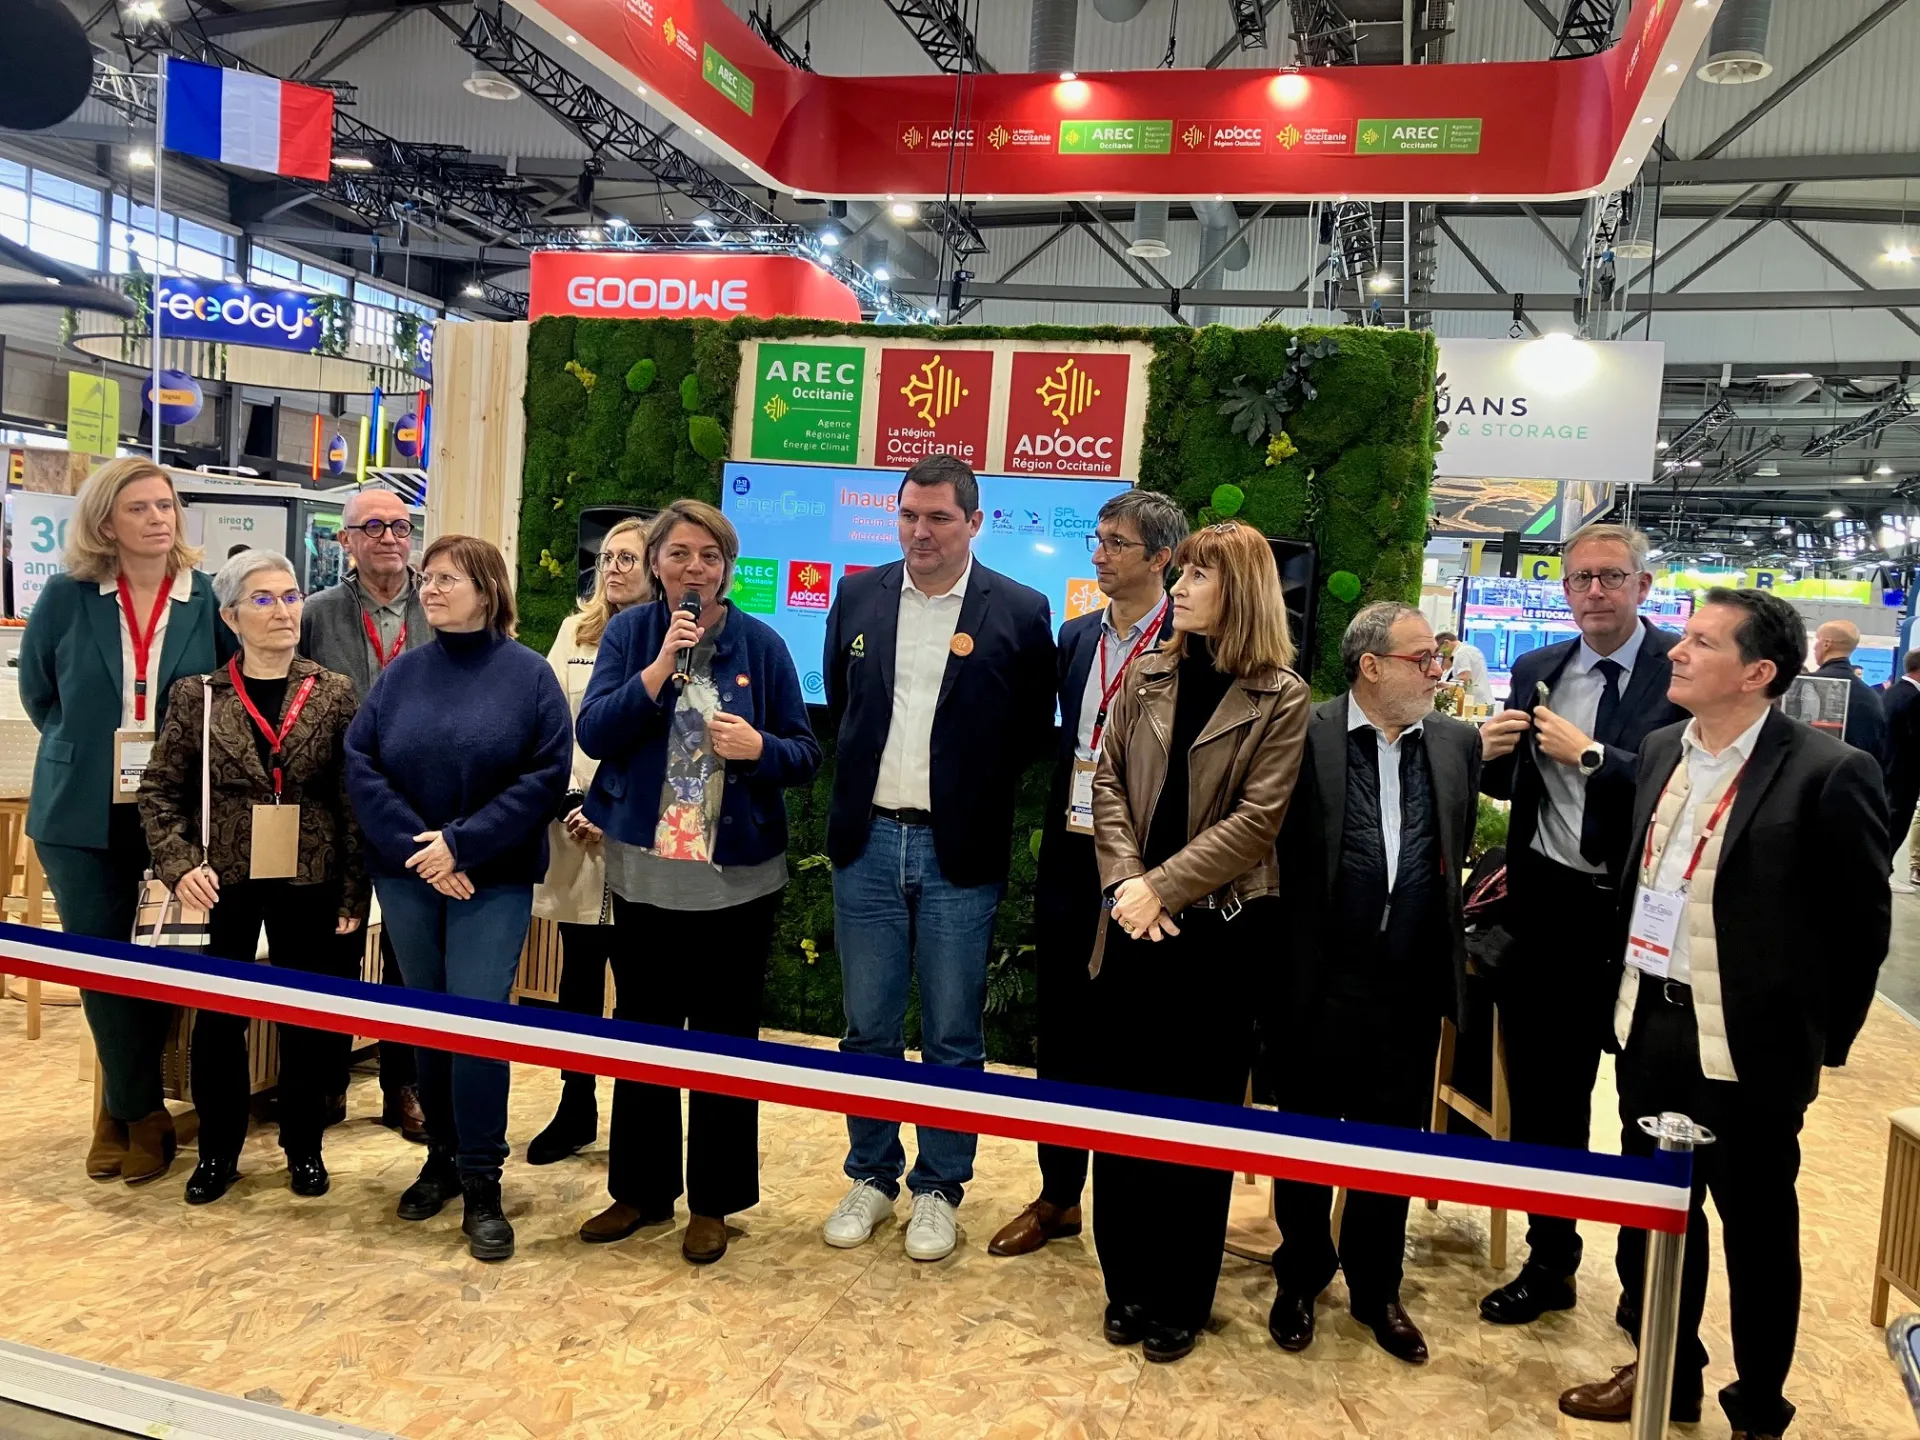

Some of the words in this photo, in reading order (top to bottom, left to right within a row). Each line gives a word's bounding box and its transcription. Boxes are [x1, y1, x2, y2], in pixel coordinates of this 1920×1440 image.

[717, 64, 738, 89] AREC
[1012, 134, 1051, 142] Occitanie
[1092, 128, 1134, 141] AREC
[1214, 125, 1261, 141] AD'OCC
[1304, 133, 1347, 141] Occitanie
[1392, 127, 1439, 140] AREC
[1099, 142, 1133, 150] Occitanie
[567, 276, 748, 311] GOODWE
[766, 360, 855, 385] AREC
[792, 386, 854, 401] Occitanie
[817, 419, 852, 429] Agence
[805, 430, 850, 440] Régionale
[888, 427, 899, 436] La
[901, 427, 936, 439] Région
[1458, 422, 1471, 436] &
[1481, 423, 1589, 440] STORAGE
[783, 439, 818, 451] Énergie
[820, 443, 850, 452] Climat
[887, 438, 974, 456] Occitanie
[1014, 428, 1113, 459] AD'OCC
[886, 455, 919, 464] Pyrénées
[1012, 457, 1053, 472] Région
[1056, 459, 1112, 472] Occitanie
[841, 488, 898, 513] Inaug
[1054, 507, 1080, 518] SPL
[218, 515, 242, 525] sirea
[853, 515, 884, 527] Forum
[734, 564, 774, 577] AREC
[1532, 560, 1550, 581] C
[790, 590, 826, 602] AD'OCC
[1522, 609, 1534, 618] LE
